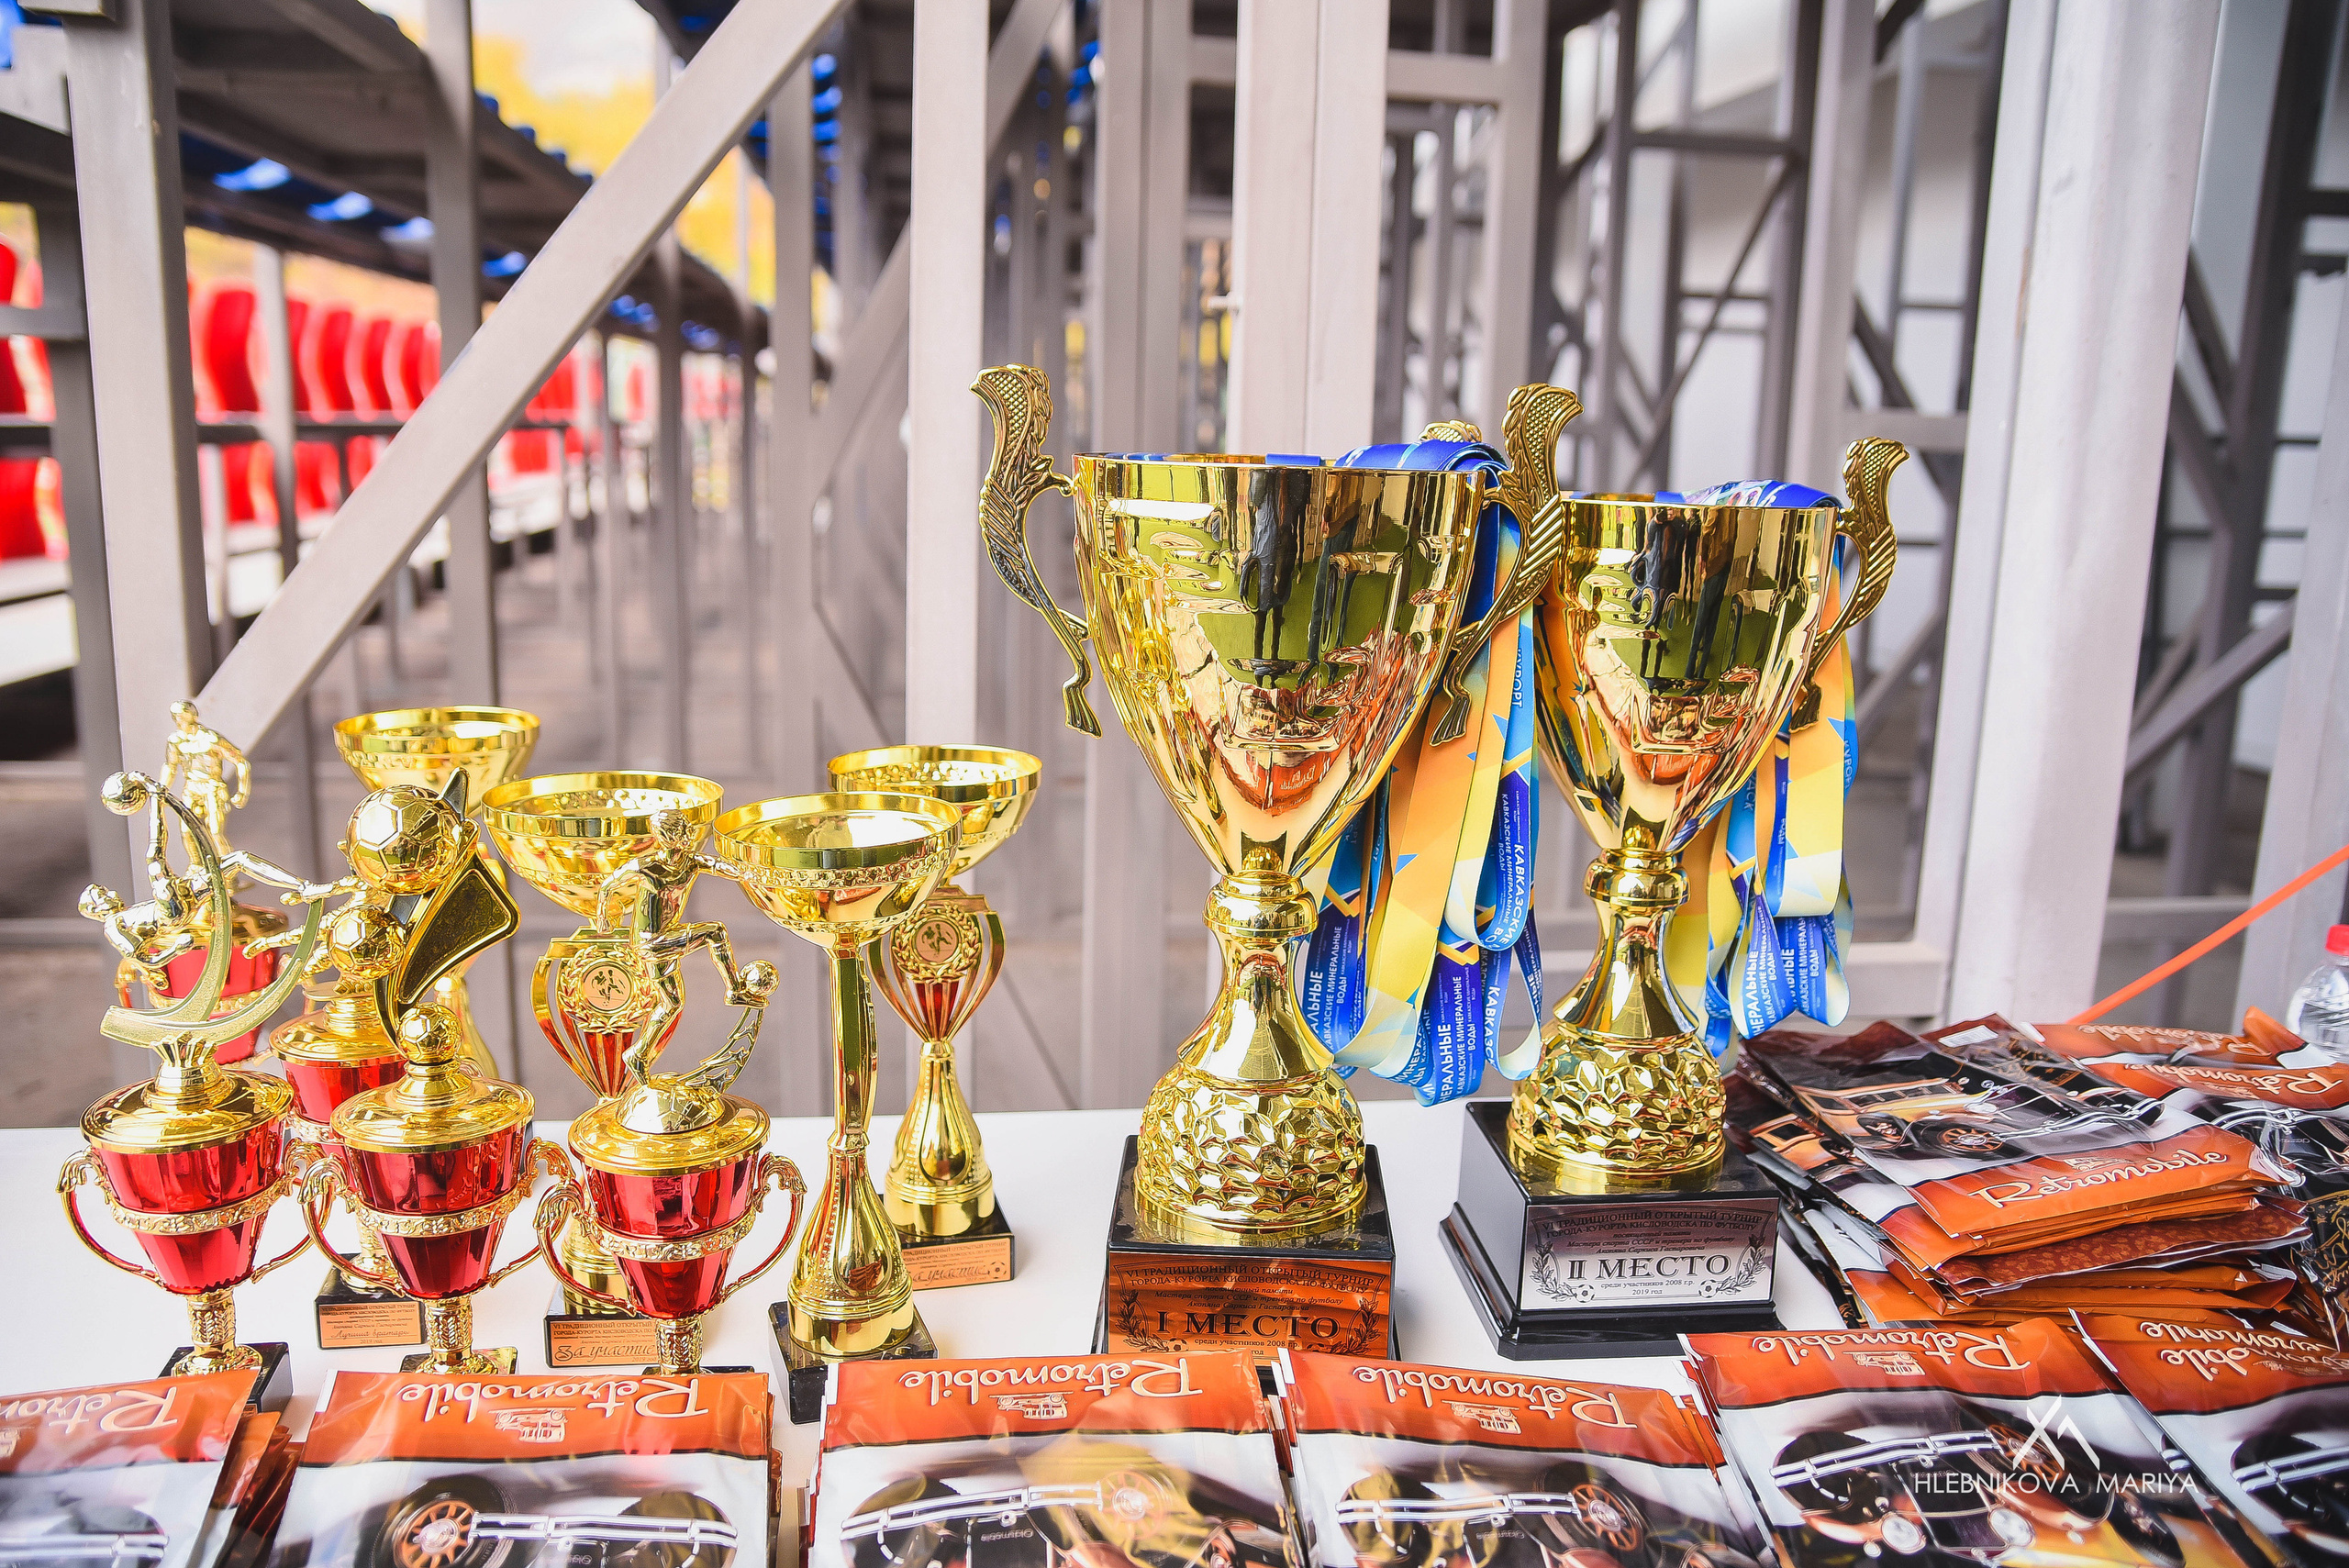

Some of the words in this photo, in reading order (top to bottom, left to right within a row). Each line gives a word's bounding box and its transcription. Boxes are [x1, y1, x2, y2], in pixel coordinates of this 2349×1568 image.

[1501, 793, 1513, 855] КАВКАЗСКИЕ
[1497, 842, 1506, 872] ВОДЫ
[1499, 843, 1525, 945] КАВКАЗСКИЕ
[1503, 854, 1513, 924] МИНЕРАЛЬНЫЕ
[1327, 926, 1342, 994] МИНЕРАЛЬНЫЕ
[1767, 952, 1777, 981] ВОДЫ
[1809, 949, 1820, 977] ВОДЫ
[1336, 976, 1347, 1005] ВОДЫ
[1453, 976, 1465, 1043] МИНЕРАЛЬНЫЕ
[1467, 1023, 1477, 1051] ВОДЫ
[1456, 1043, 1467, 1095] КАВКАЗСКИЕ
[1967, 1148, 2230, 1208] Retromobile
[1546, 1222, 1628, 1239] ГОРОДА-КУРОРТА
[1630, 1220, 1698, 1229] КИСЛОВОДСКА
[1715, 1222, 1757, 1230] ФУТБОЛУ
[1556, 1210, 1653, 1228] ТРАДИЦИОННЫЙ
[1654, 1210, 1717, 1220] ОТКРЫТЫЙ
[1720, 1212, 1763, 1223] ТУРНИР
[1125, 1270, 1140, 1278] VI
[1142, 1264, 1248, 1276] ТРАДИЦИОННЫЙ
[1251, 1266, 1321, 1280] ОТКРЫТЫЙ
[1325, 1272, 1374, 1285] ТУРНИР
[1567, 1259, 1587, 1281] II
[1595, 1254, 1732, 1281] МЕСТО
[1131, 1275, 1220, 1286] ГОРОДА-КУРОРТА
[1223, 1275, 1299, 1285] КИСЛОВОДСКА
[1320, 1281, 1368, 1294] ФУТБОЛУ
[1154, 1291, 1192, 1300] Мастера
[1308, 1296, 1344, 1305] футболу
[1156, 1311, 1170, 1334] I
[1182, 1312, 1341, 1340] МЕСТО
[586, 1344, 655, 1363] участие
[1219, 1339, 1265, 1347] участников
[1751, 1329, 2031, 1373] Retromobile
[898, 1357, 1203, 1406] Retromobile
[1353, 1363, 1638, 1429] Retromobile
[396, 1377, 709, 1423] Retromobile
